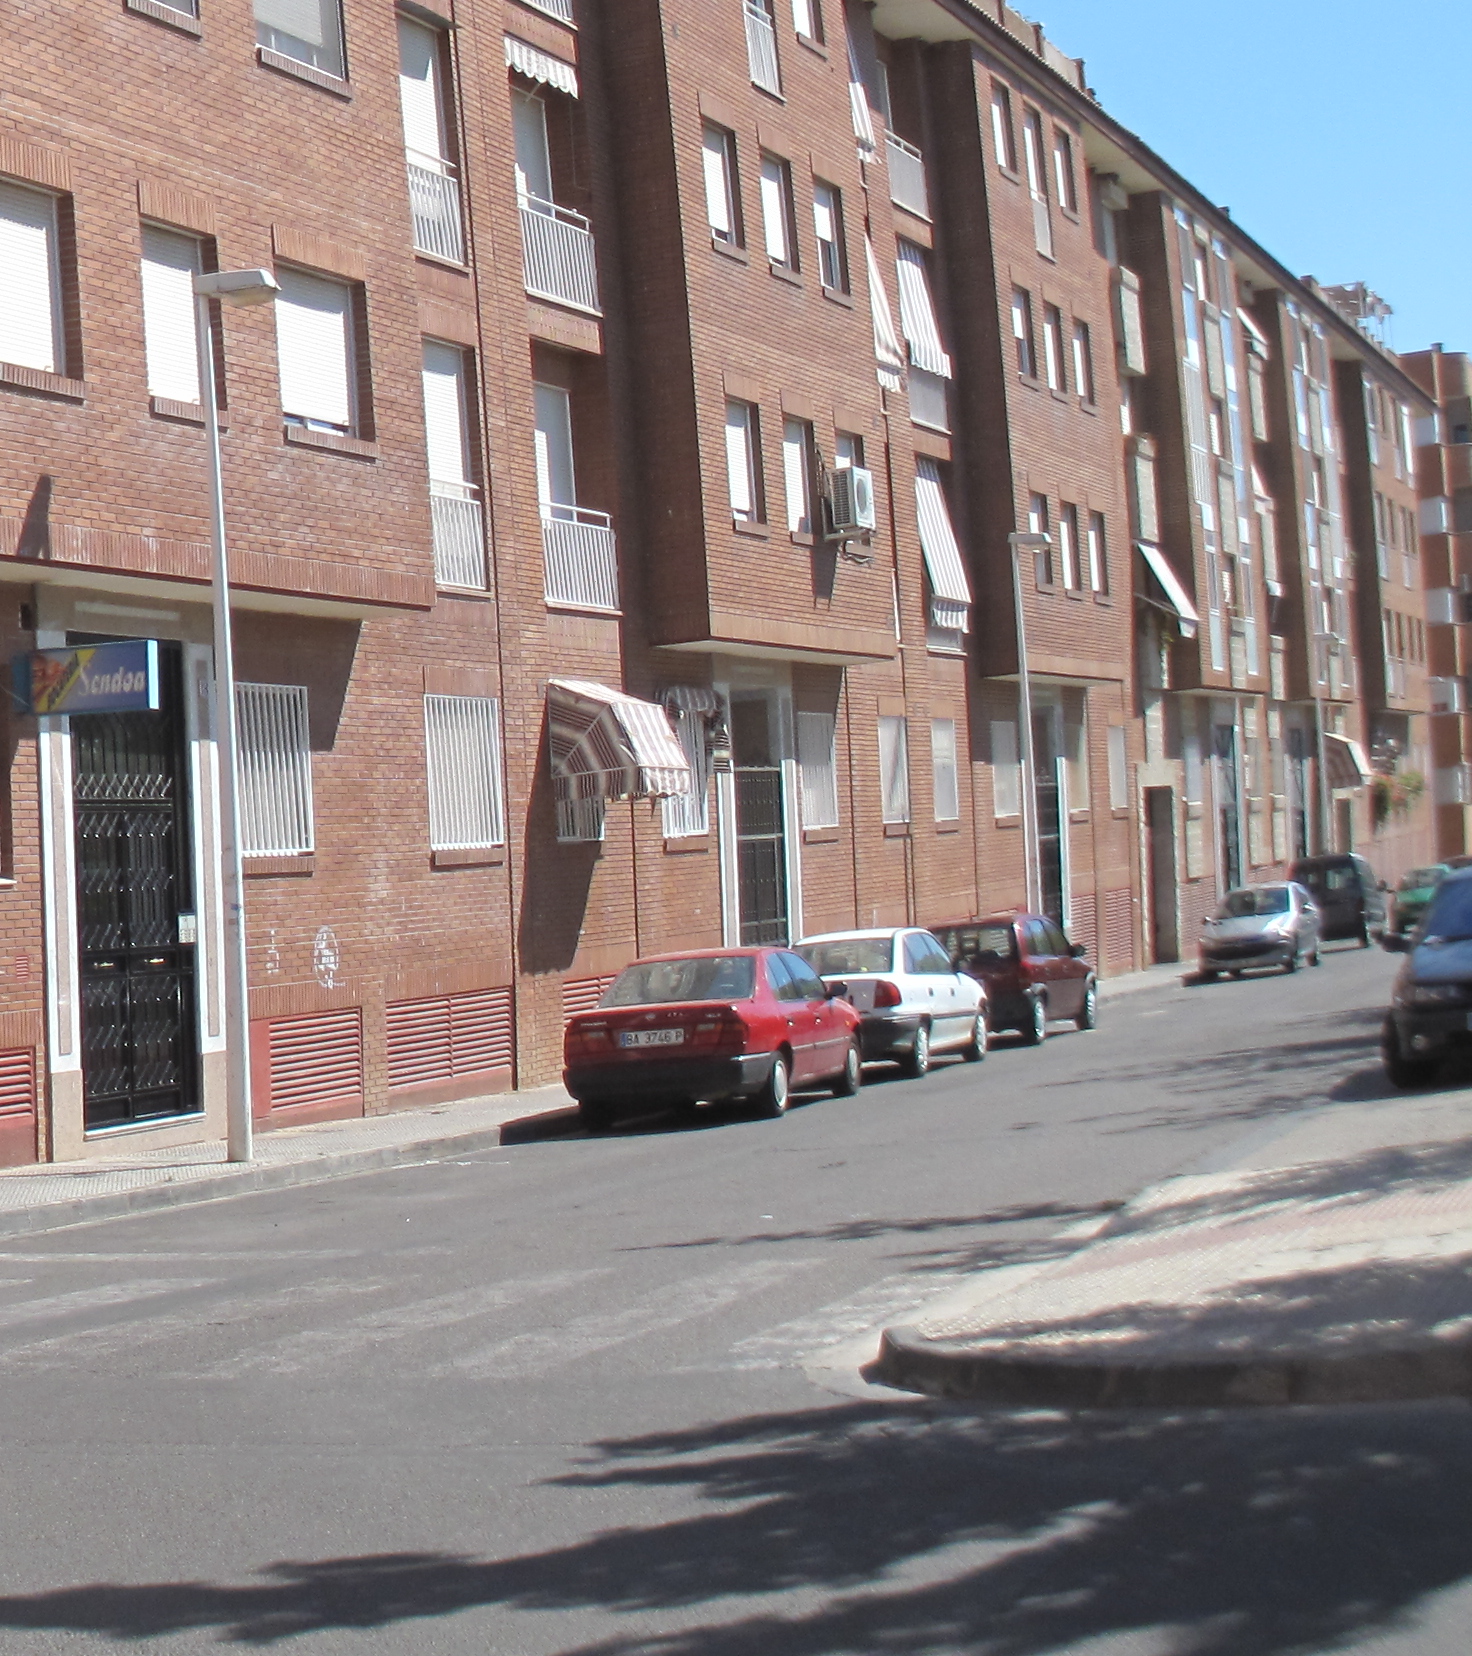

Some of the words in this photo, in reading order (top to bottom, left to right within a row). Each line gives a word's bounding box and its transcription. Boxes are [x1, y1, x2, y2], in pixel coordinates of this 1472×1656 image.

[78, 661, 146, 696] Sendoa
[626, 1033, 640, 1045] BA
[674, 1028, 684, 1041] P
